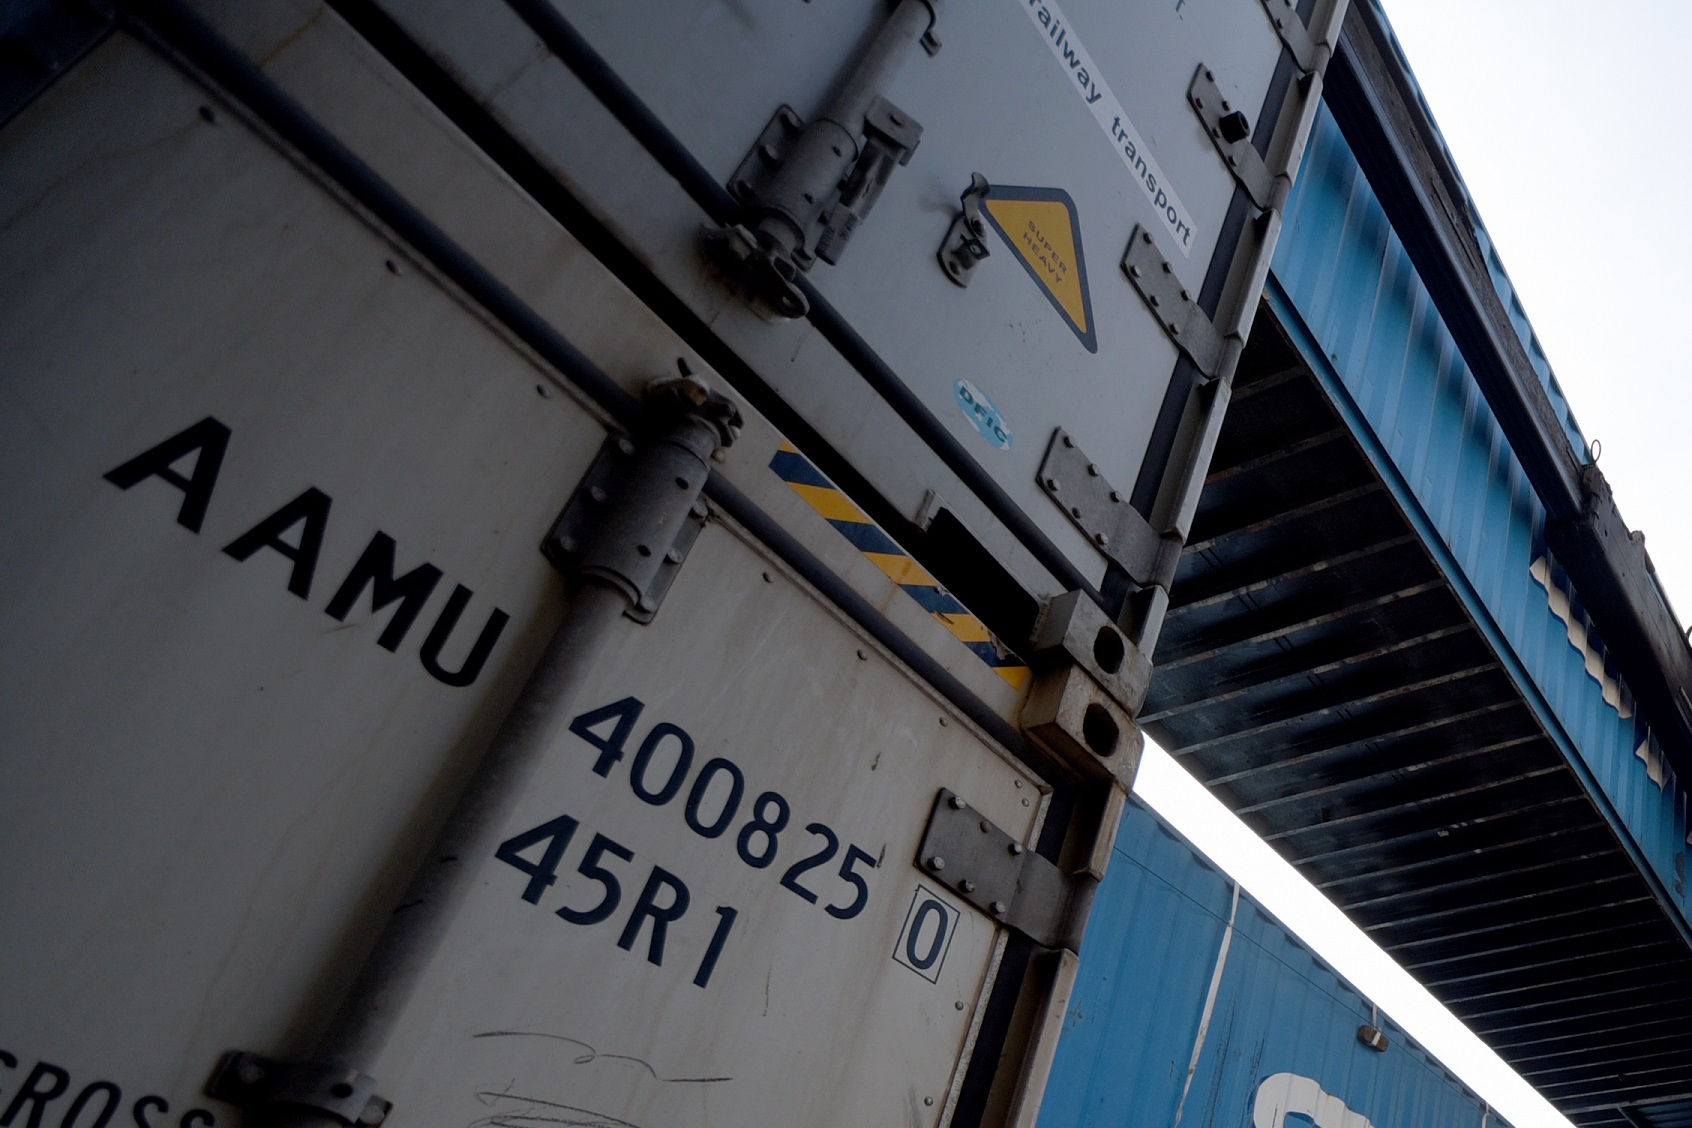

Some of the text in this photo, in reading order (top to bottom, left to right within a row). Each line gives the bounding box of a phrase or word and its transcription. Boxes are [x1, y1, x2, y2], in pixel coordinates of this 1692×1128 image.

[1023, 232, 1063, 284] HEAVY
[1027, 220, 1068, 276] SUPER
[1111, 116, 1192, 247] transport
[103, 416, 511, 687] AAMU
[494, 813, 739, 989] 45R1
[568, 696, 949, 970] 400825 0
